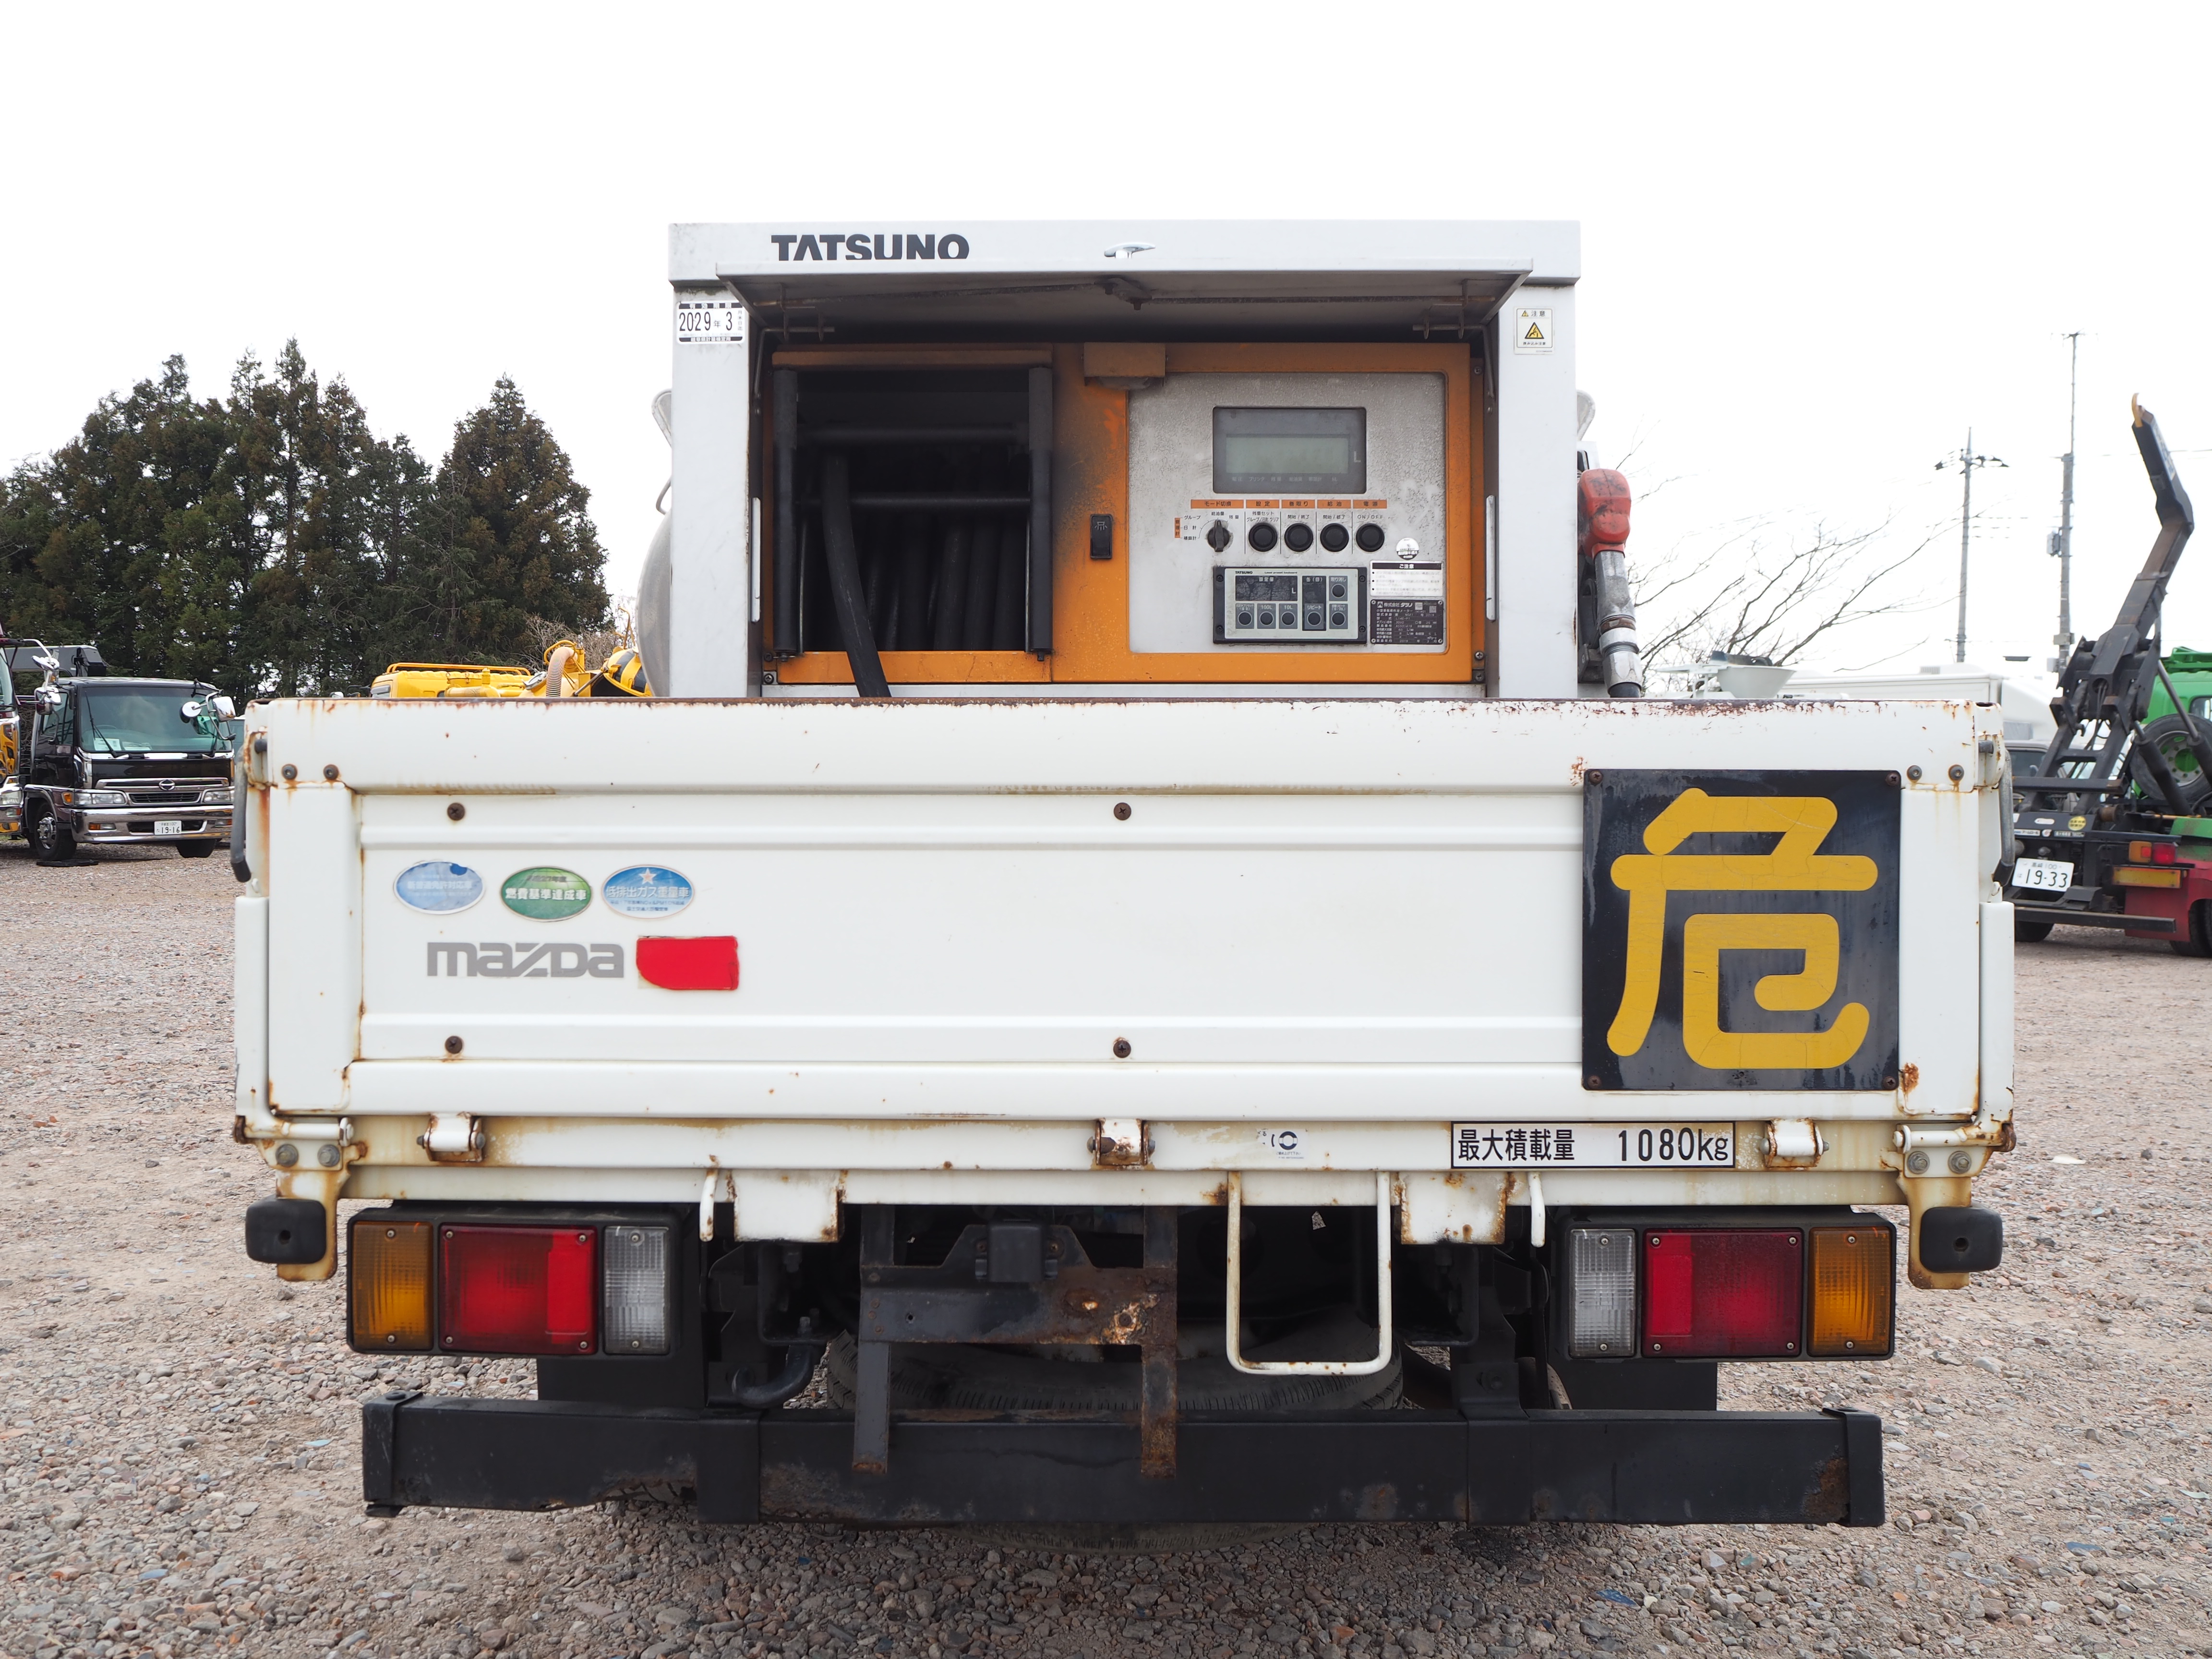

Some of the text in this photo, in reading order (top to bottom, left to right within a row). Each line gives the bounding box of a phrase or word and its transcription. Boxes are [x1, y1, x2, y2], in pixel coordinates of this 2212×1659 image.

[771, 233, 970, 261] TATSUNO
[1354, 451, 1361, 463] L
[2025, 869, 2068, 888] 19-33
[505, 887, 587, 901] 燃費基準達成車
[606, 886, 689, 899] 低排出ガス重量車
[1606, 787, 1878, 1070] 危
[1457, 1127, 1729, 1163] 最大積載量 1080kg
